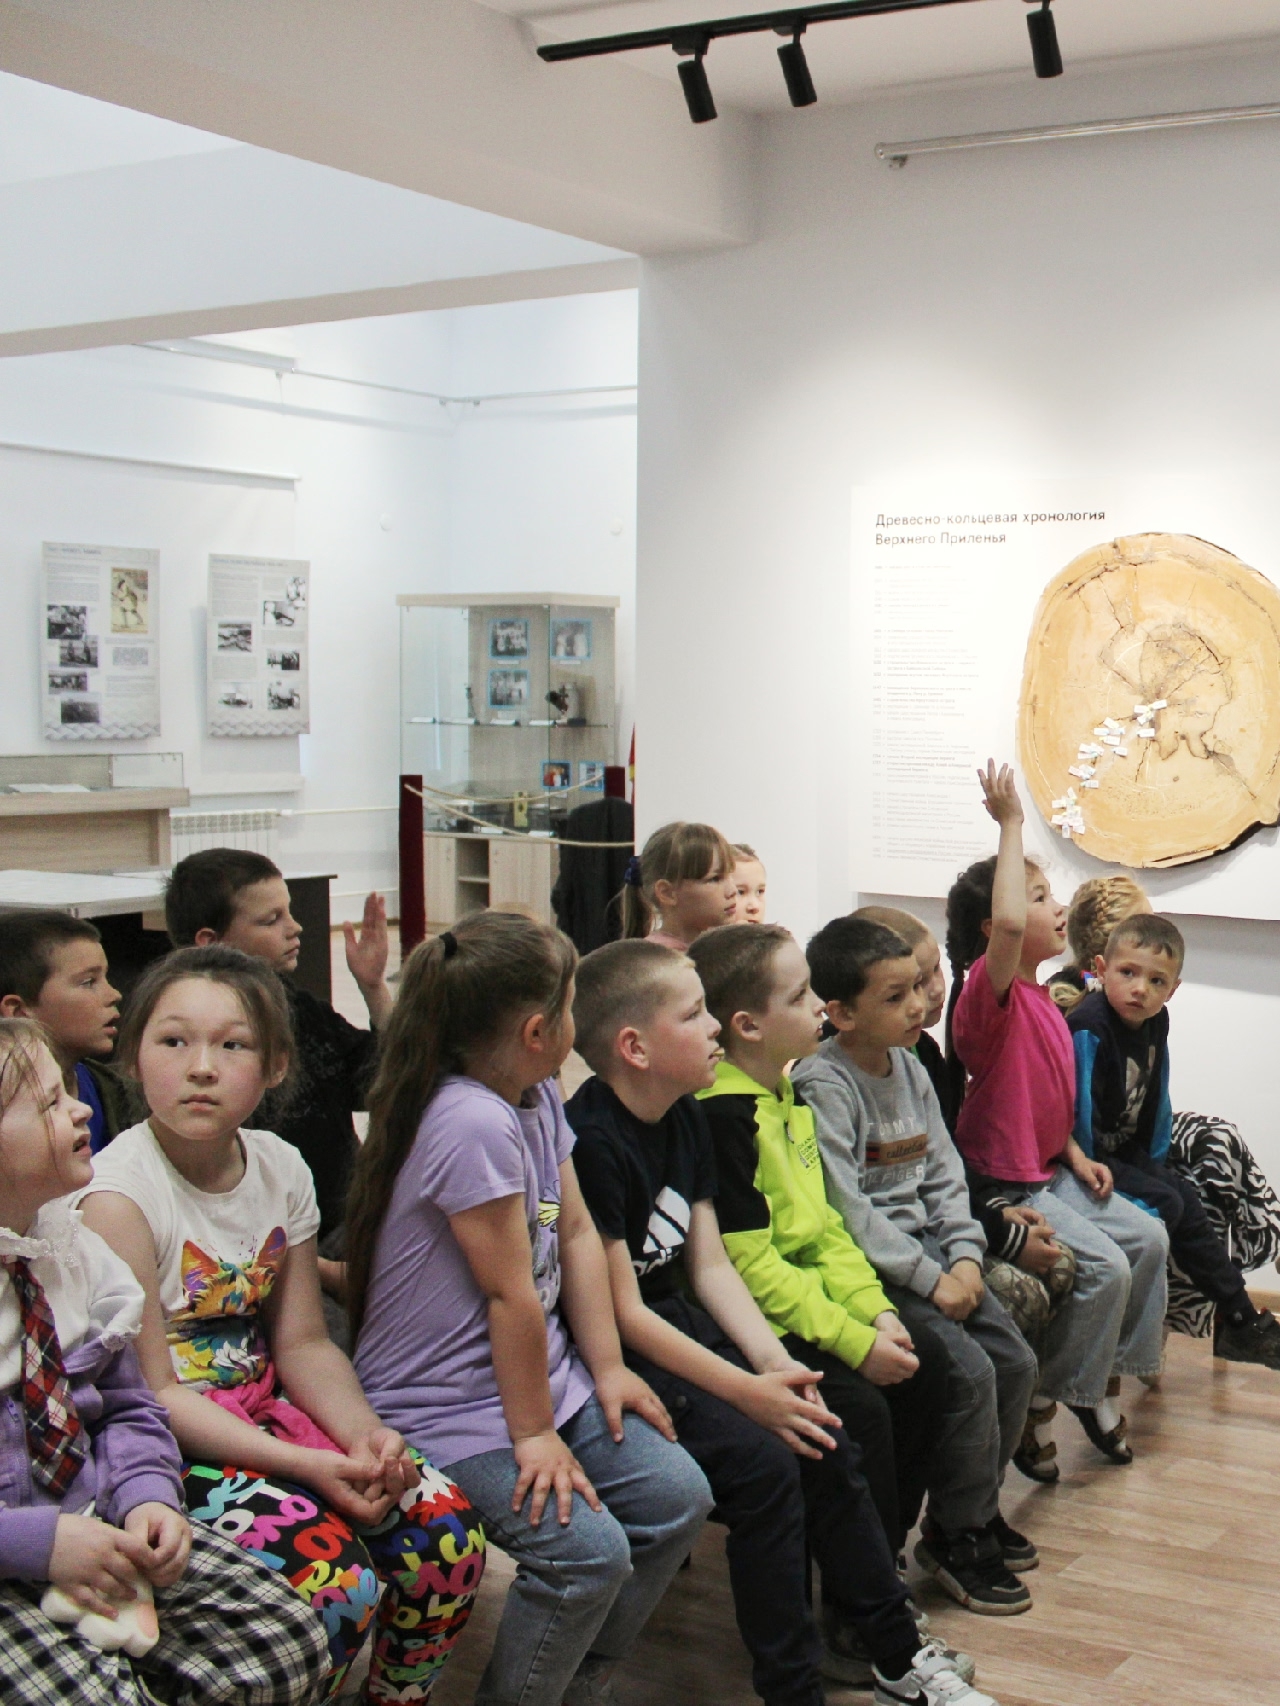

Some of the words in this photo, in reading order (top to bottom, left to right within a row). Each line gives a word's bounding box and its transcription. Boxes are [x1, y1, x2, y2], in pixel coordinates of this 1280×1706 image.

[876, 513, 1018, 529] Древесно-кольцевая
[1023, 511, 1105, 525] хронология
[876, 533, 936, 548] Верхнего
[941, 532, 1006, 547] Приленья
